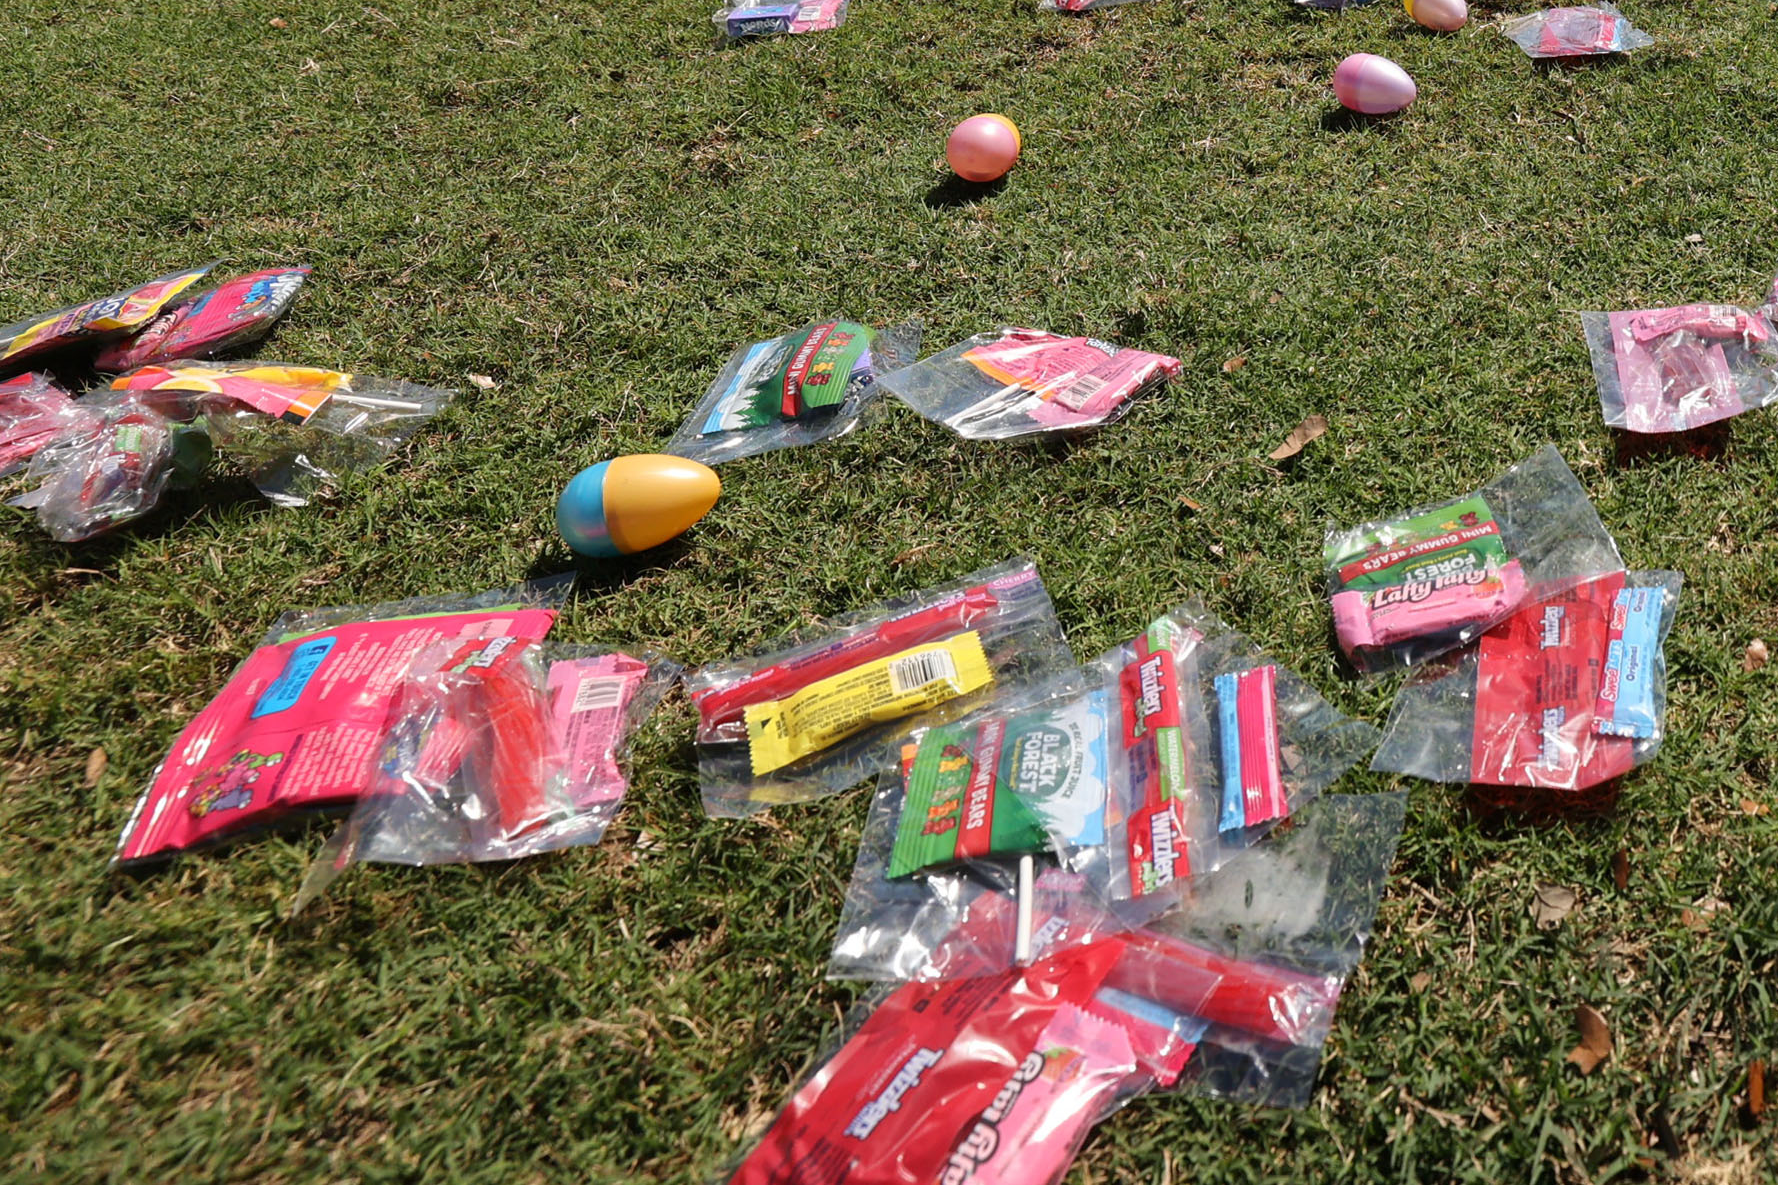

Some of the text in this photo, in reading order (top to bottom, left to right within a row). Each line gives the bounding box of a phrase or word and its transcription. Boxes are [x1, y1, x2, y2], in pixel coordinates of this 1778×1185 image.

[786, 326, 829, 395] MINI GUMMY BEARS
[1410, 535, 1459, 555] GUMMY
[1461, 524, 1493, 538] MINI
[991, 569, 1037, 588] CHERRY
[1404, 552, 1477, 584] FOREST
[1372, 579, 1432, 609] Laffy
[1625, 645, 1641, 682] Original
[1139, 655, 1166, 716] Twizzlers
[973, 747, 996, 789] GUMMY
[1019, 731, 1043, 793] FOREST
[1038, 734, 1061, 788] BLACK
[1071, 752, 1084, 776] FRUIT
[966, 786, 988, 831] BEARS
[1062, 775, 1080, 800] JUICE
[1150, 804, 1181, 889] Twizzlers
[846, 1046, 944, 1140] Twizzlers
[941, 1121, 1001, 1184] affy
